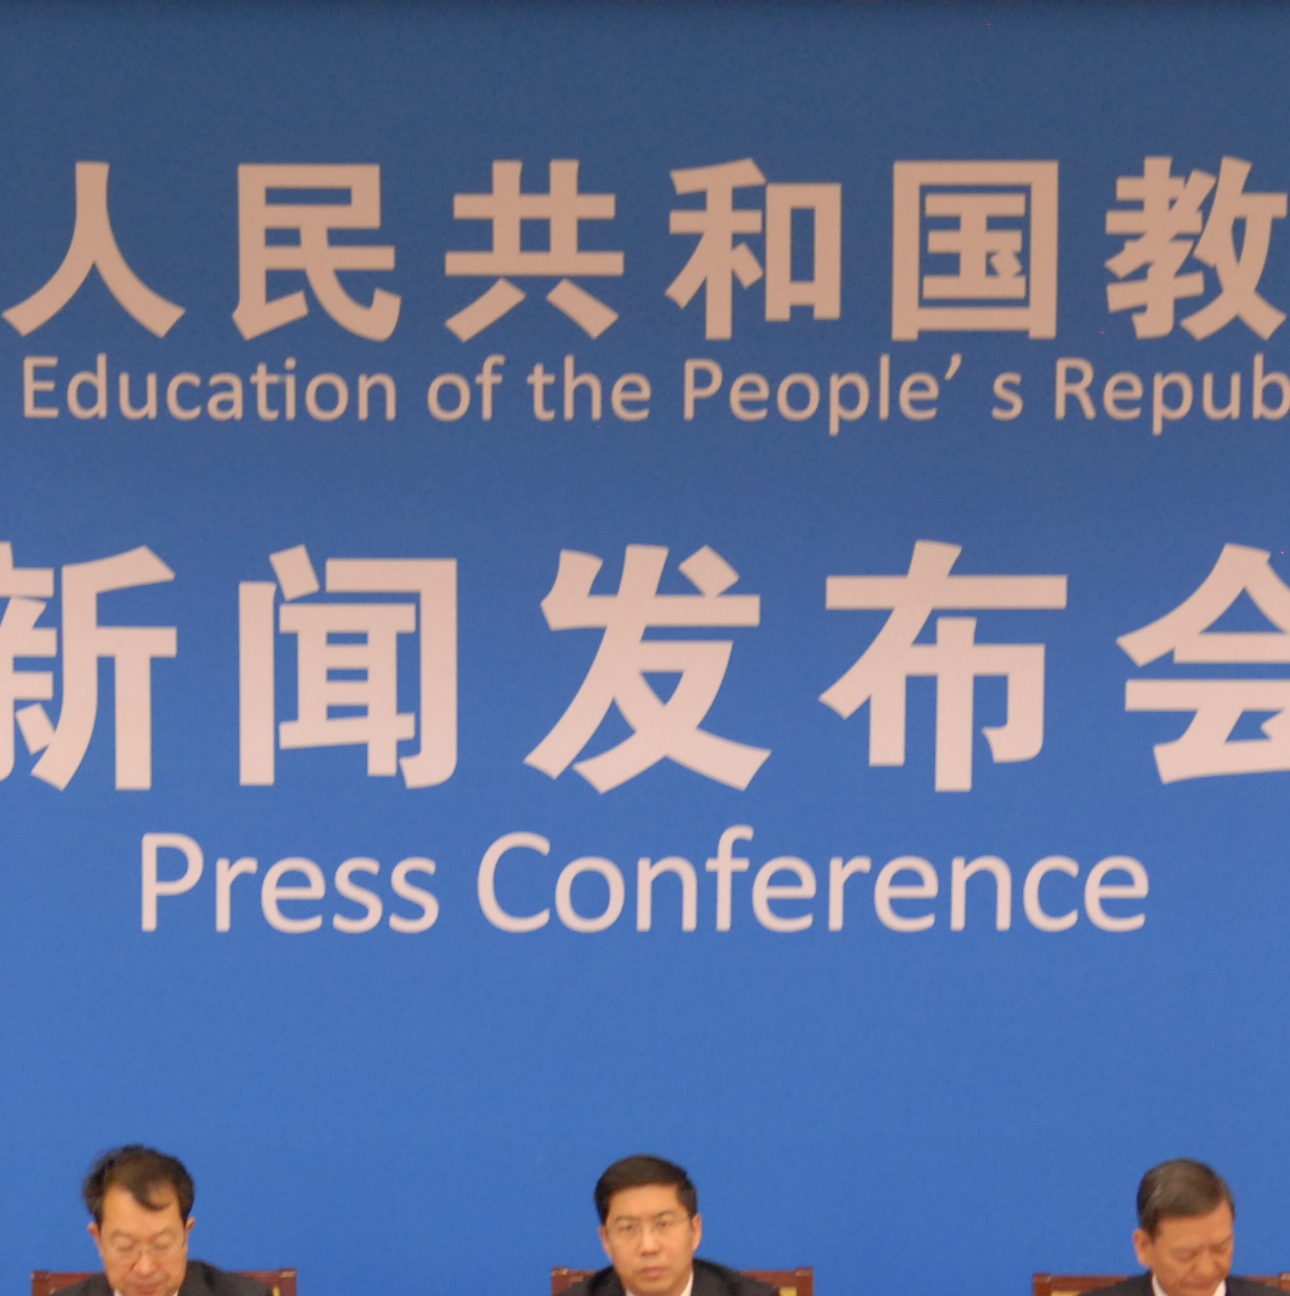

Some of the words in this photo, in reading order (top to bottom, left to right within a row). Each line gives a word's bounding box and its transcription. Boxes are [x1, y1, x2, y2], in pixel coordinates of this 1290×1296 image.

[24, 354, 396, 421] Education
[428, 355, 504, 421] of
[527, 355, 651, 421] the
[140, 832, 440, 934] Press
[476, 824, 1150, 934] Conference
